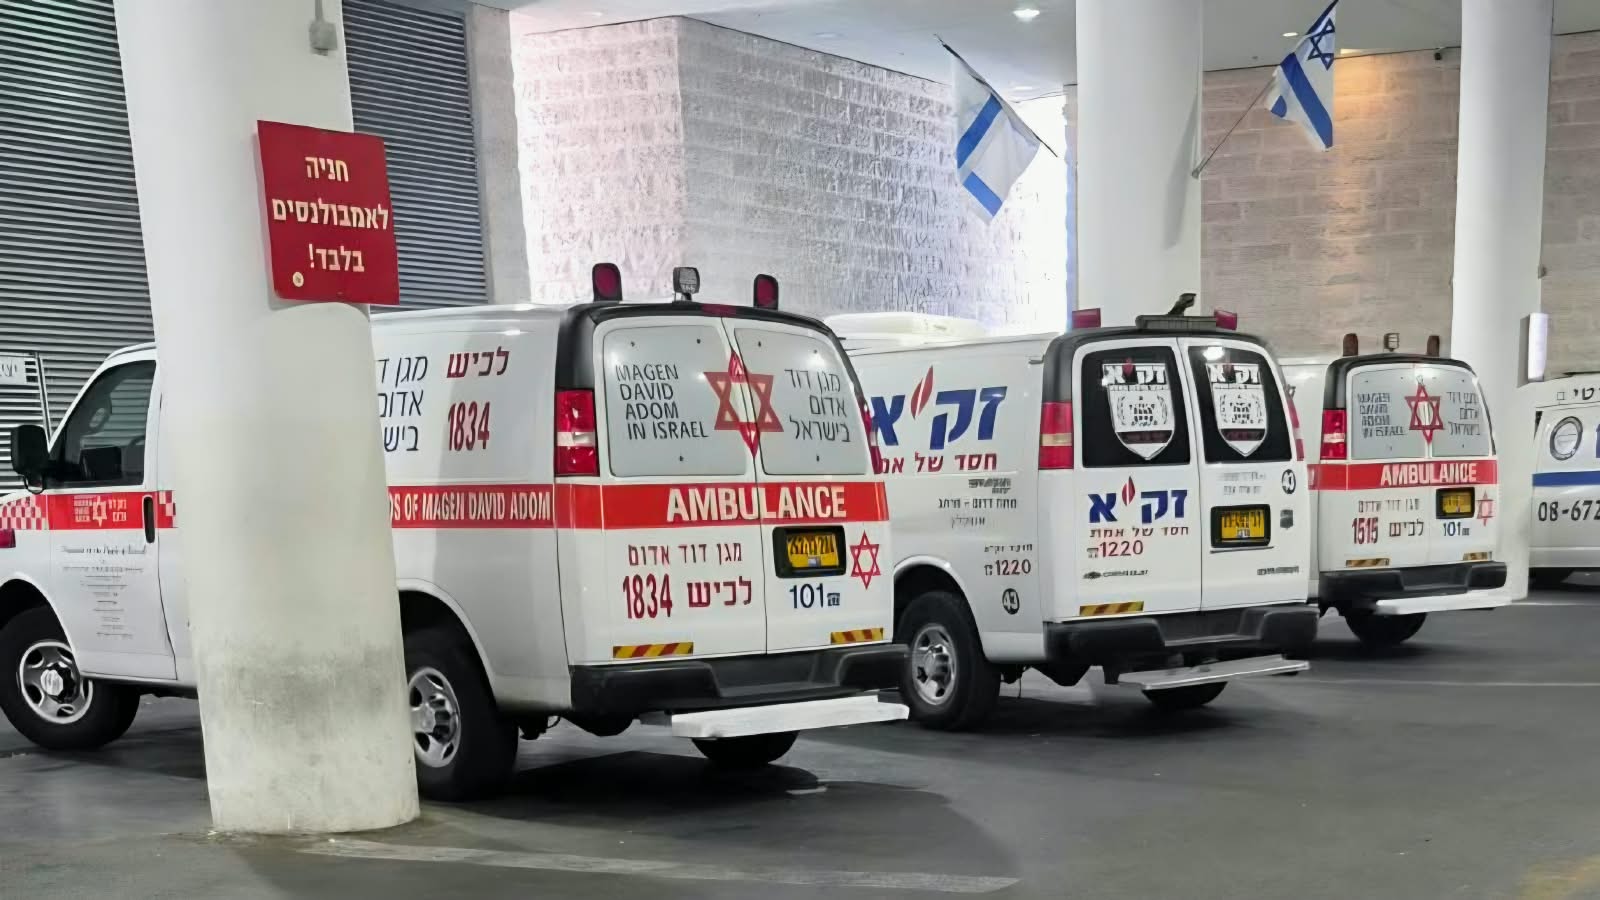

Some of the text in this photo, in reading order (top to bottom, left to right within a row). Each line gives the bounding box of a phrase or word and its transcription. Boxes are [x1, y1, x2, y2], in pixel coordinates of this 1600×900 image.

[304, 156, 349, 182] חניה
[272, 198, 389, 231] לאמבולנסים
[308, 243, 365, 273] בלבד!
[395, 355, 428, 388] מגן
[446, 346, 510, 378] לכיש
[615, 363, 679, 382] MAGEN
[620, 382, 674, 401] DAVID
[784, 368, 841, 393] מגן דוד
[625, 402, 679, 420] ADOM
[809, 394, 848, 418] אדום
[383, 425, 420, 453] ביש
[447, 401, 491, 451] 1834
[627, 420, 710, 440] IN ISRAEL
[789, 415, 851, 442] בישראל
[880, 452, 997, 473] חסד של אמ
[1380, 462, 1477, 486] AMBULANCE
[404, 492, 418, 520] OF
[422, 492, 465, 520] MAGEN
[469, 491, 505, 520] DAVID
[510, 491, 551, 520] ADOM
[666, 485, 847, 522] AMBULANCE
[1090, 526, 1189, 538] חסד של אמת
[628, 542, 743, 567] מגן דוד אדום
[1099, 540, 1144, 558] 1220
[995, 558, 1031, 576] 1220
[622, 573, 673, 619] 1834
[686, 575, 752, 608] לכיש
[789, 583, 825, 609] 101
